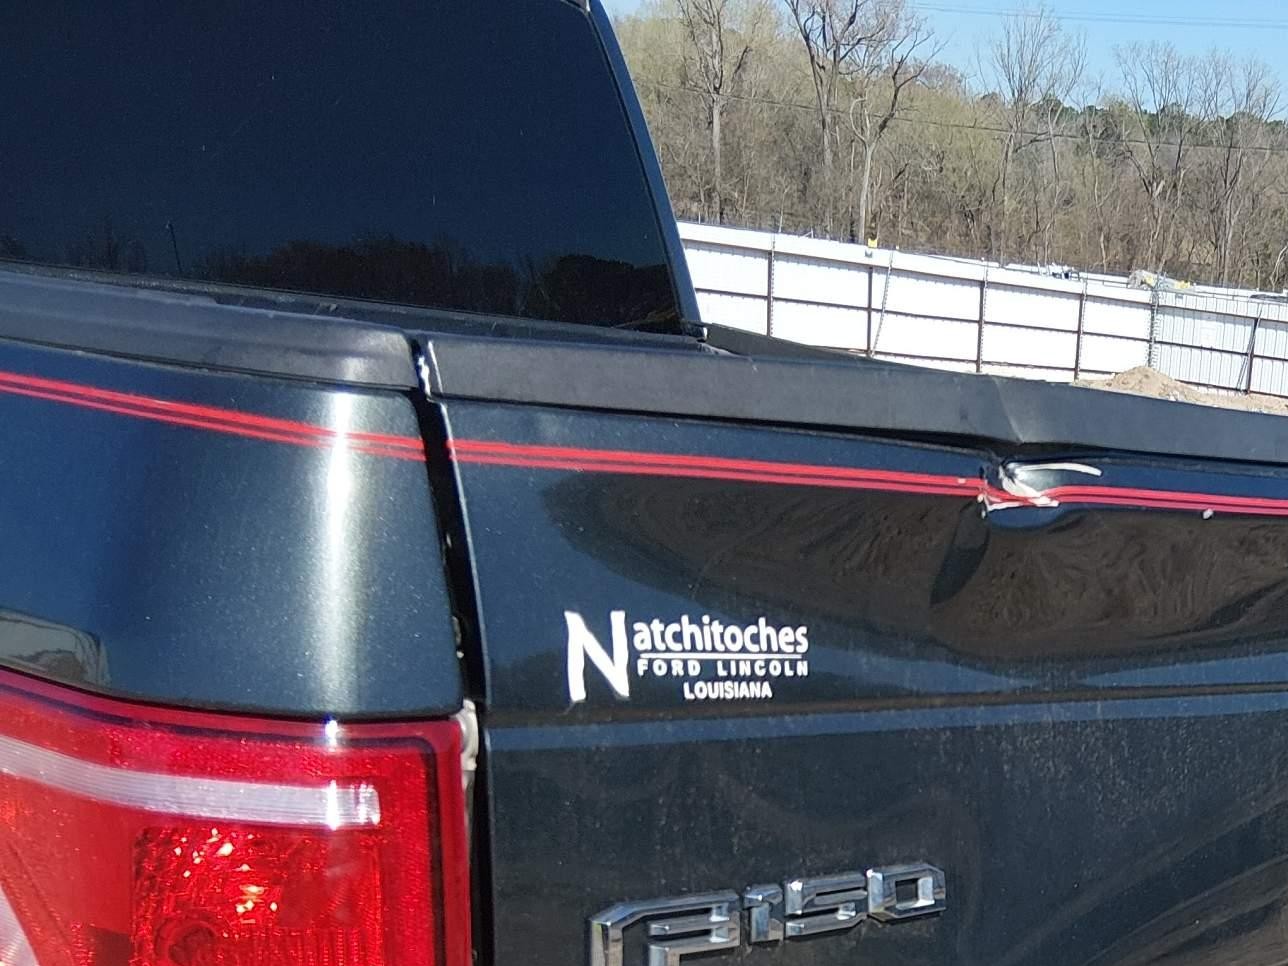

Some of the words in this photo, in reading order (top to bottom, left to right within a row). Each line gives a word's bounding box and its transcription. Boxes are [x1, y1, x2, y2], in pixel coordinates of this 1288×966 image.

[564, 610, 809, 702] Natchitoches
[637, 659, 701, 677] FORD
[716, 659, 809, 677] LINCOLN
[683, 681, 774, 700] LOUISIANA
